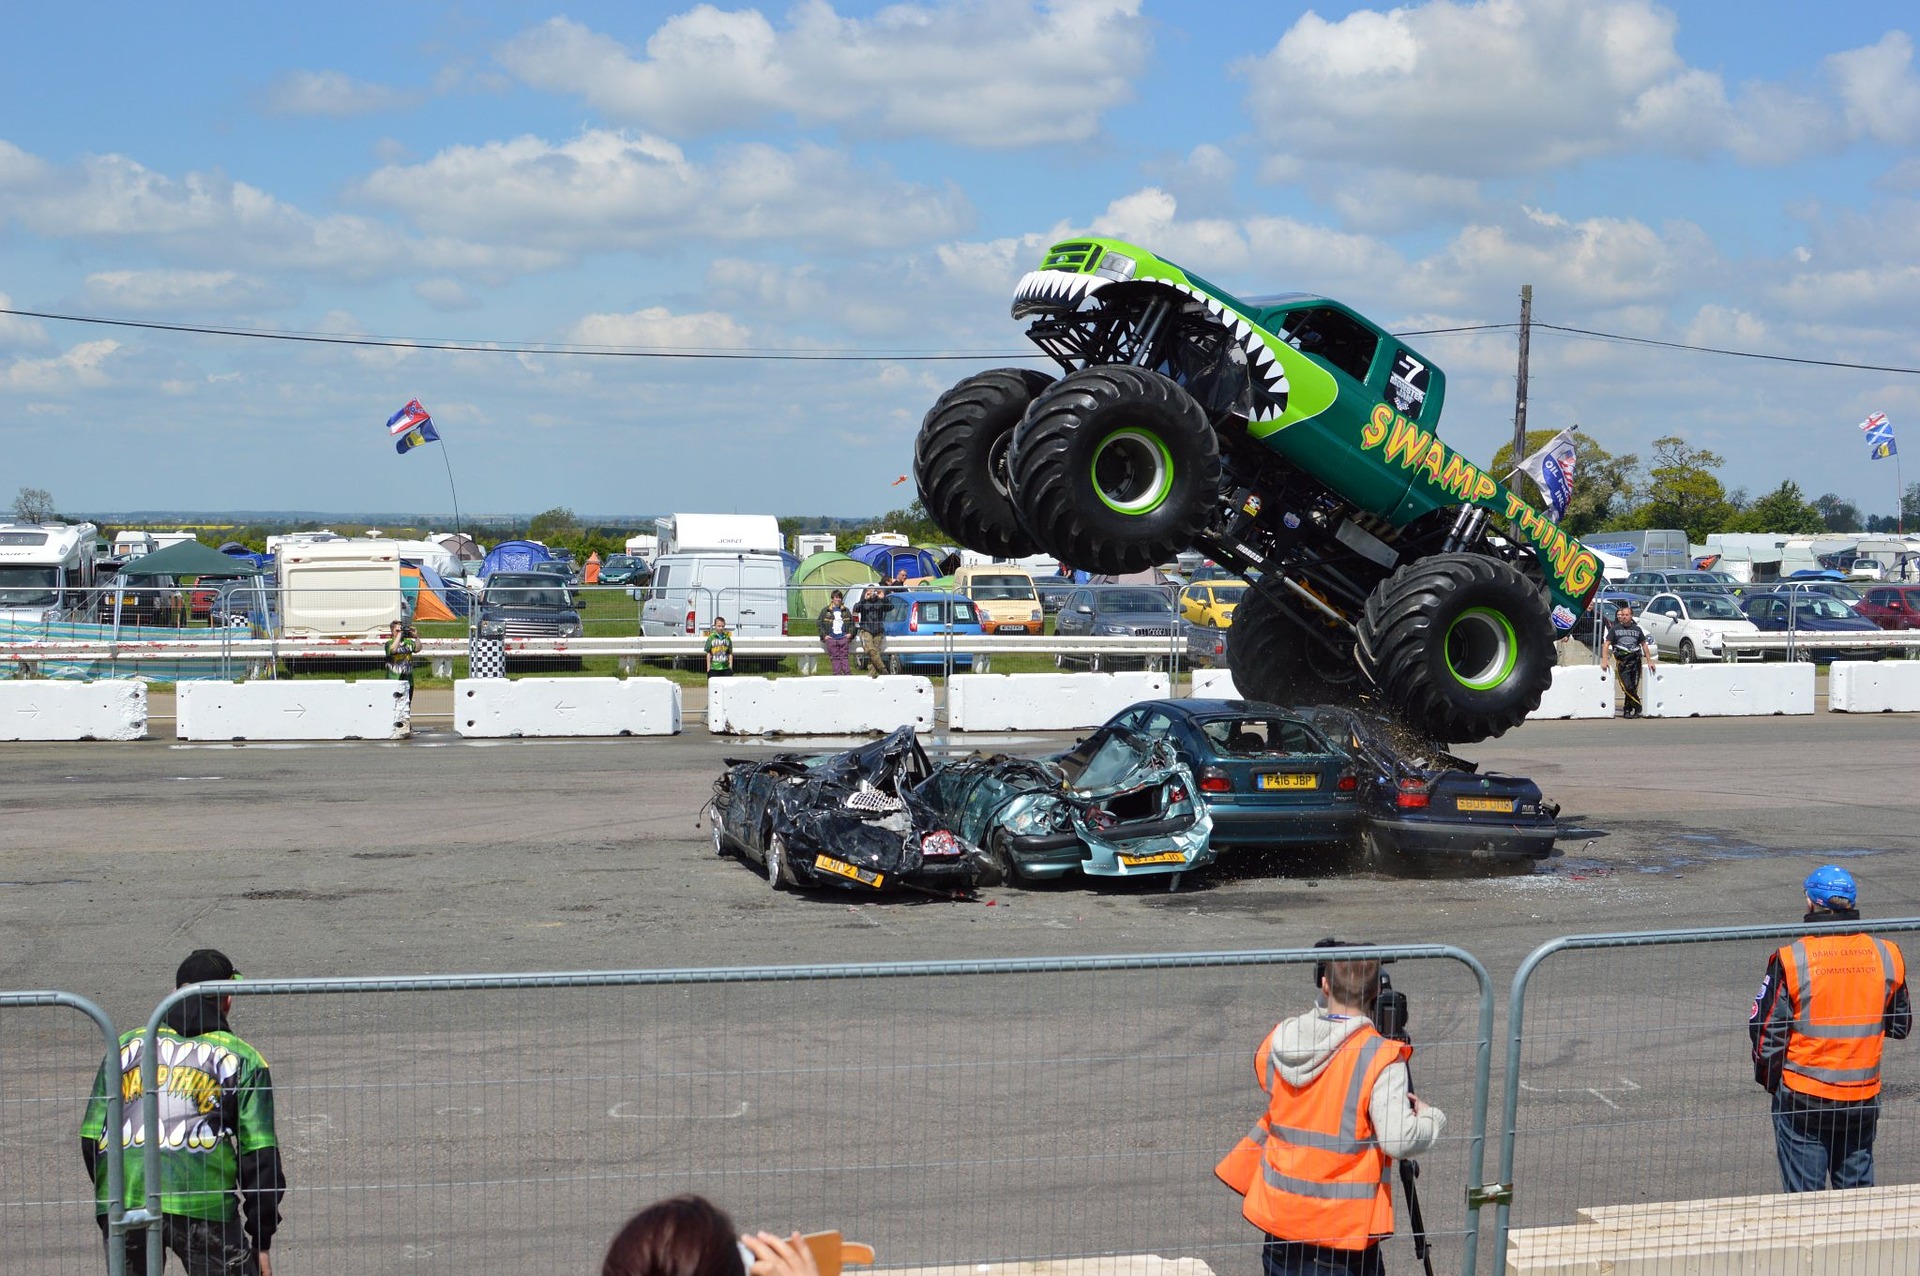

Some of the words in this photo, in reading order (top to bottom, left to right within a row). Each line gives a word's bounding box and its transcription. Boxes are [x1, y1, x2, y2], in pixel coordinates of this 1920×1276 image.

[1545, 460, 1559, 478] OIL
[1361, 403, 1497, 502] SWAMP
[1505, 490, 1597, 598] THING
[1614, 629, 1640, 638] MONSTE
[1267, 775, 1290, 786] P416
[1293, 775, 1312, 786] JBP
[1812, 949, 1838, 958] BARRY
[1840, 948, 1873, 957] CLAYSON
[1815, 966, 1877, 976] COMMENTATOR
[167, 1065, 222, 1114] THING
